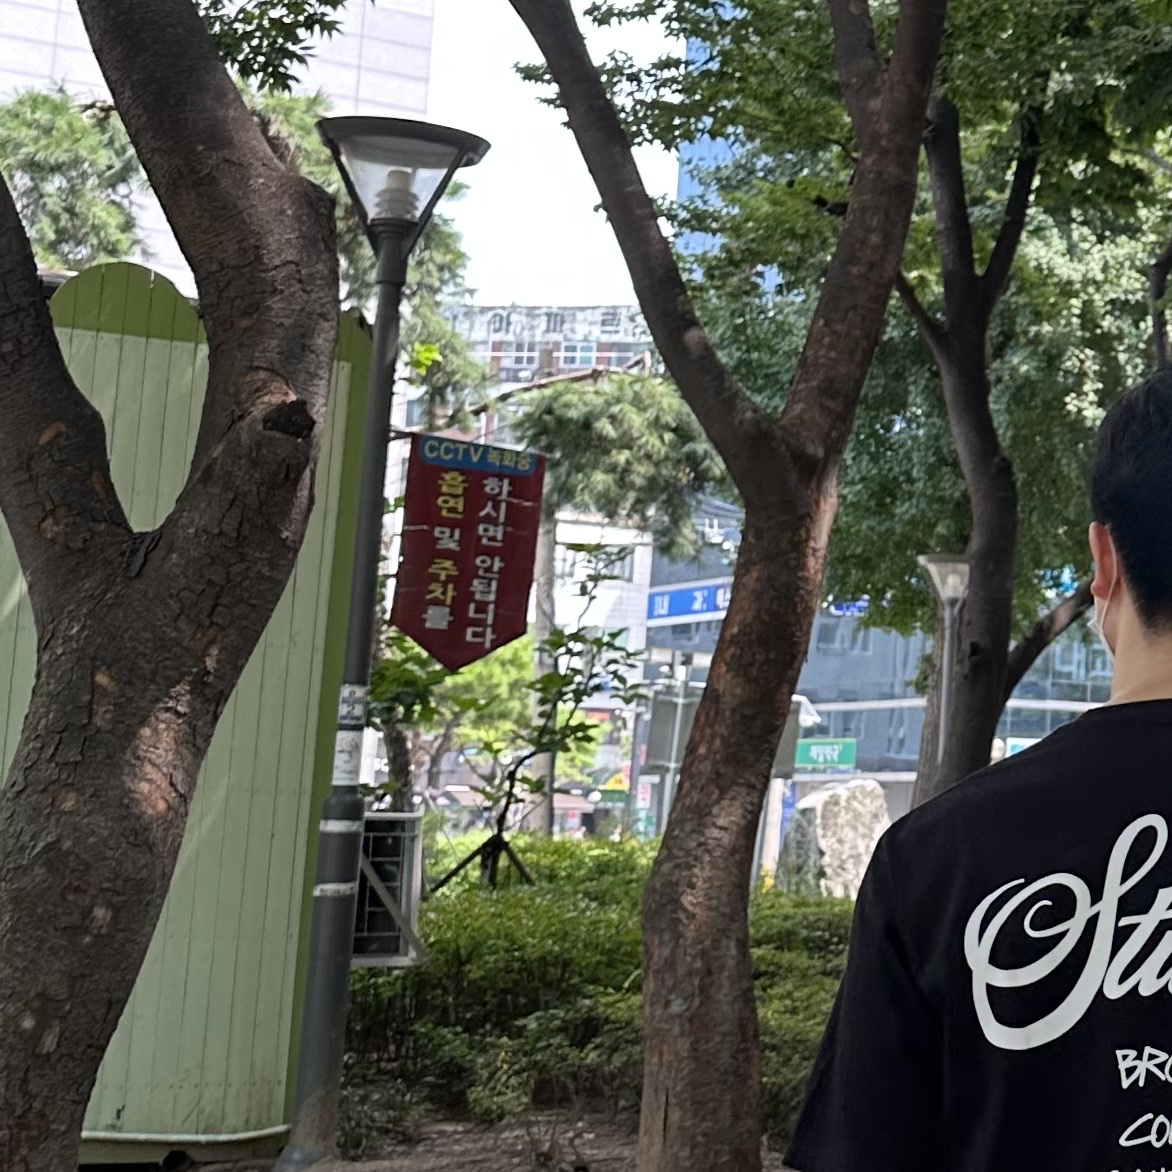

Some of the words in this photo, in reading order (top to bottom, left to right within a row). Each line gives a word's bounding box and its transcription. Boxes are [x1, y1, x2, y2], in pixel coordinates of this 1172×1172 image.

[424, 440, 484, 463] CCTV
[437, 471, 468, 518] 흡연
[478, 477, 513, 547] 하시면
[433, 526, 461, 552] 및
[422, 558, 459, 630] 주차를
[465, 555, 505, 649] 안됩니다
